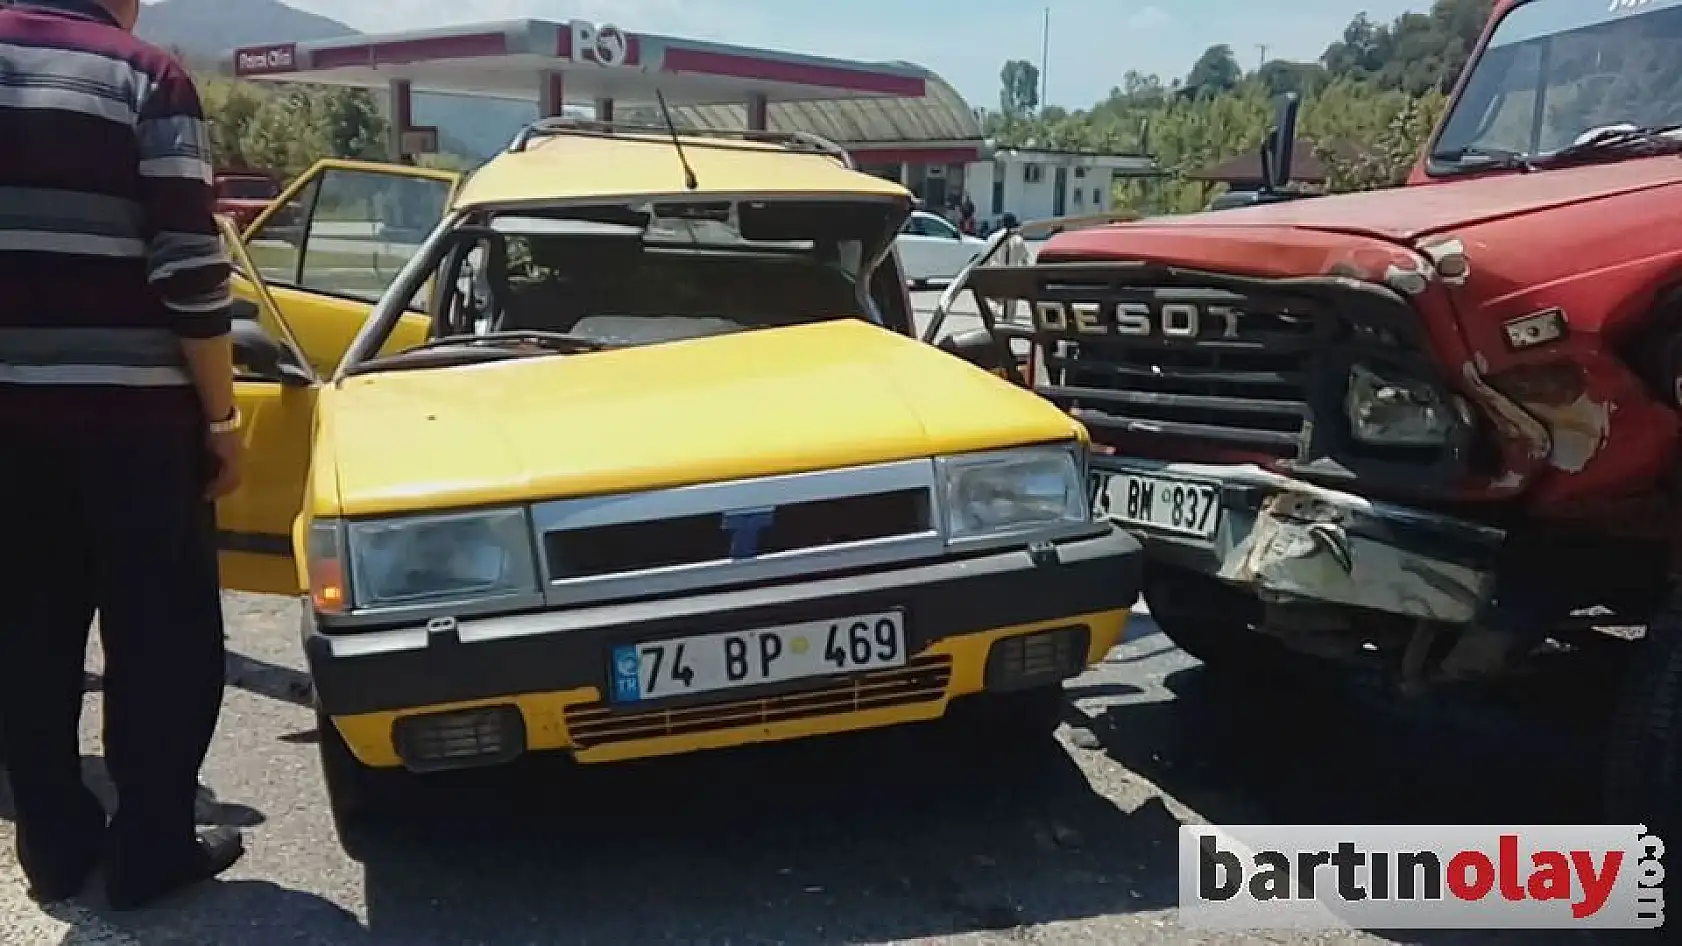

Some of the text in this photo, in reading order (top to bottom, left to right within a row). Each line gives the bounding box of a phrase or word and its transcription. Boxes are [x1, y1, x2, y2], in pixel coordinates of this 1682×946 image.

[1128, 479, 1153, 520] BM
[1172, 486, 1213, 532] 837
[641, 618, 897, 692] 74 BP 469
